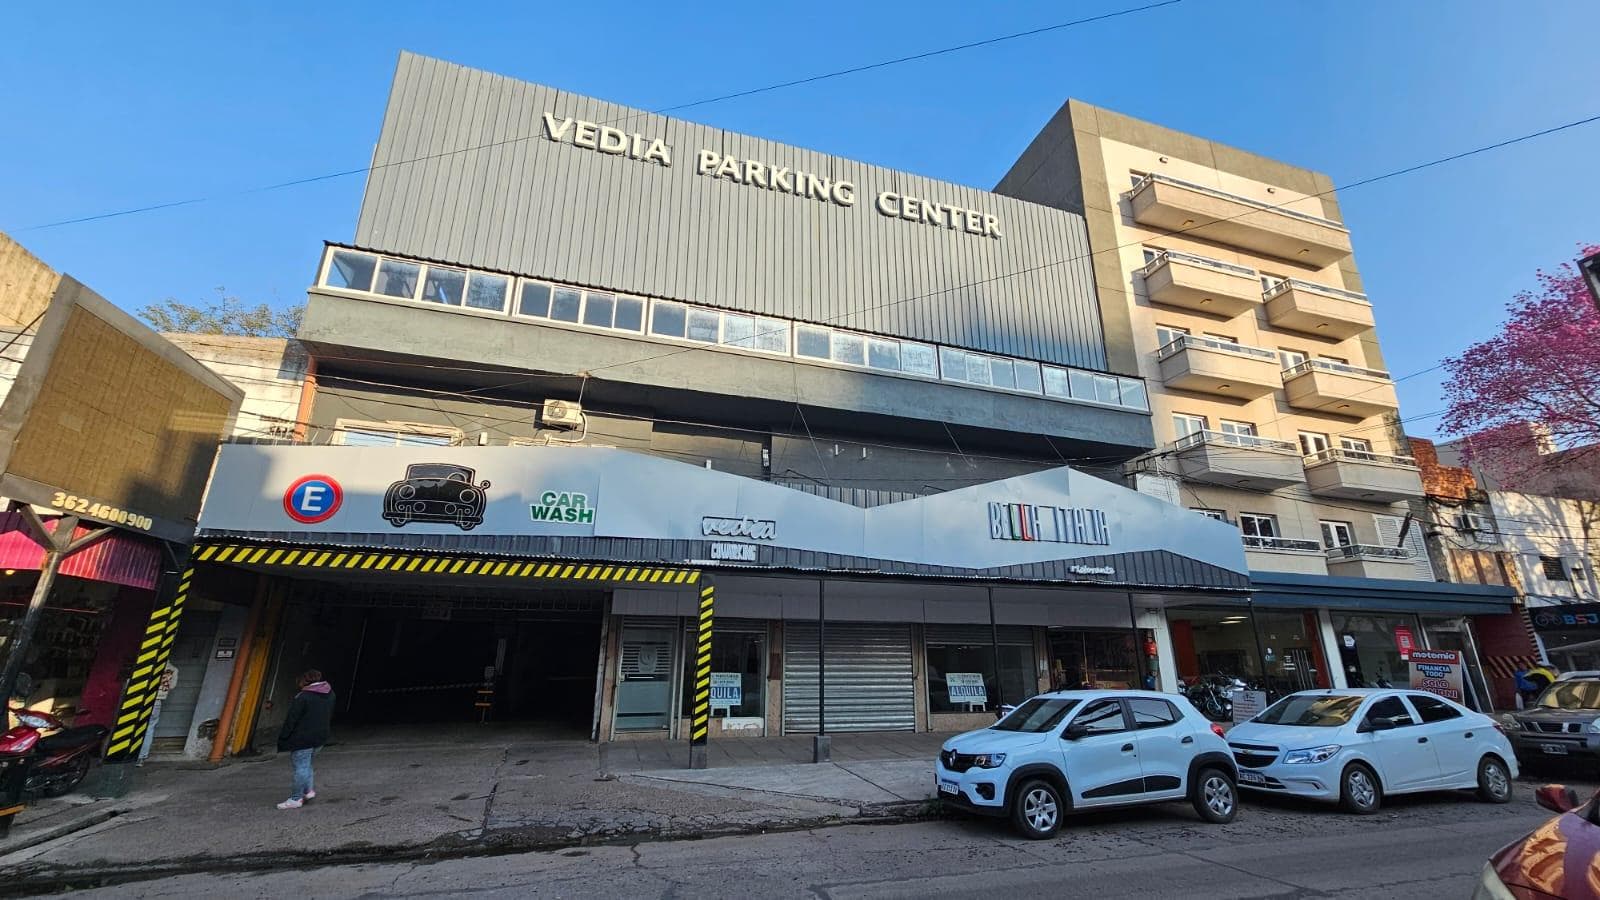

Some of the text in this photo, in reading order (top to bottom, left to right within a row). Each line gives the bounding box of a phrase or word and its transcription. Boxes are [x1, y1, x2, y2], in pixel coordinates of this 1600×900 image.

[542, 112, 1002, 239] VEDIA PARKING CENTER
[301, 486, 325, 511] E
[541, 491, 587, 509] CAR
[530, 505, 594, 524] WASH
[702, 515, 776, 540] vedia
[1412, 651, 1456, 660] motomia
[1417, 664, 1450, 672] FINANCIA
[710, 687, 738, 698] QUILA
[951, 686, 985, 696] ALQUILA
